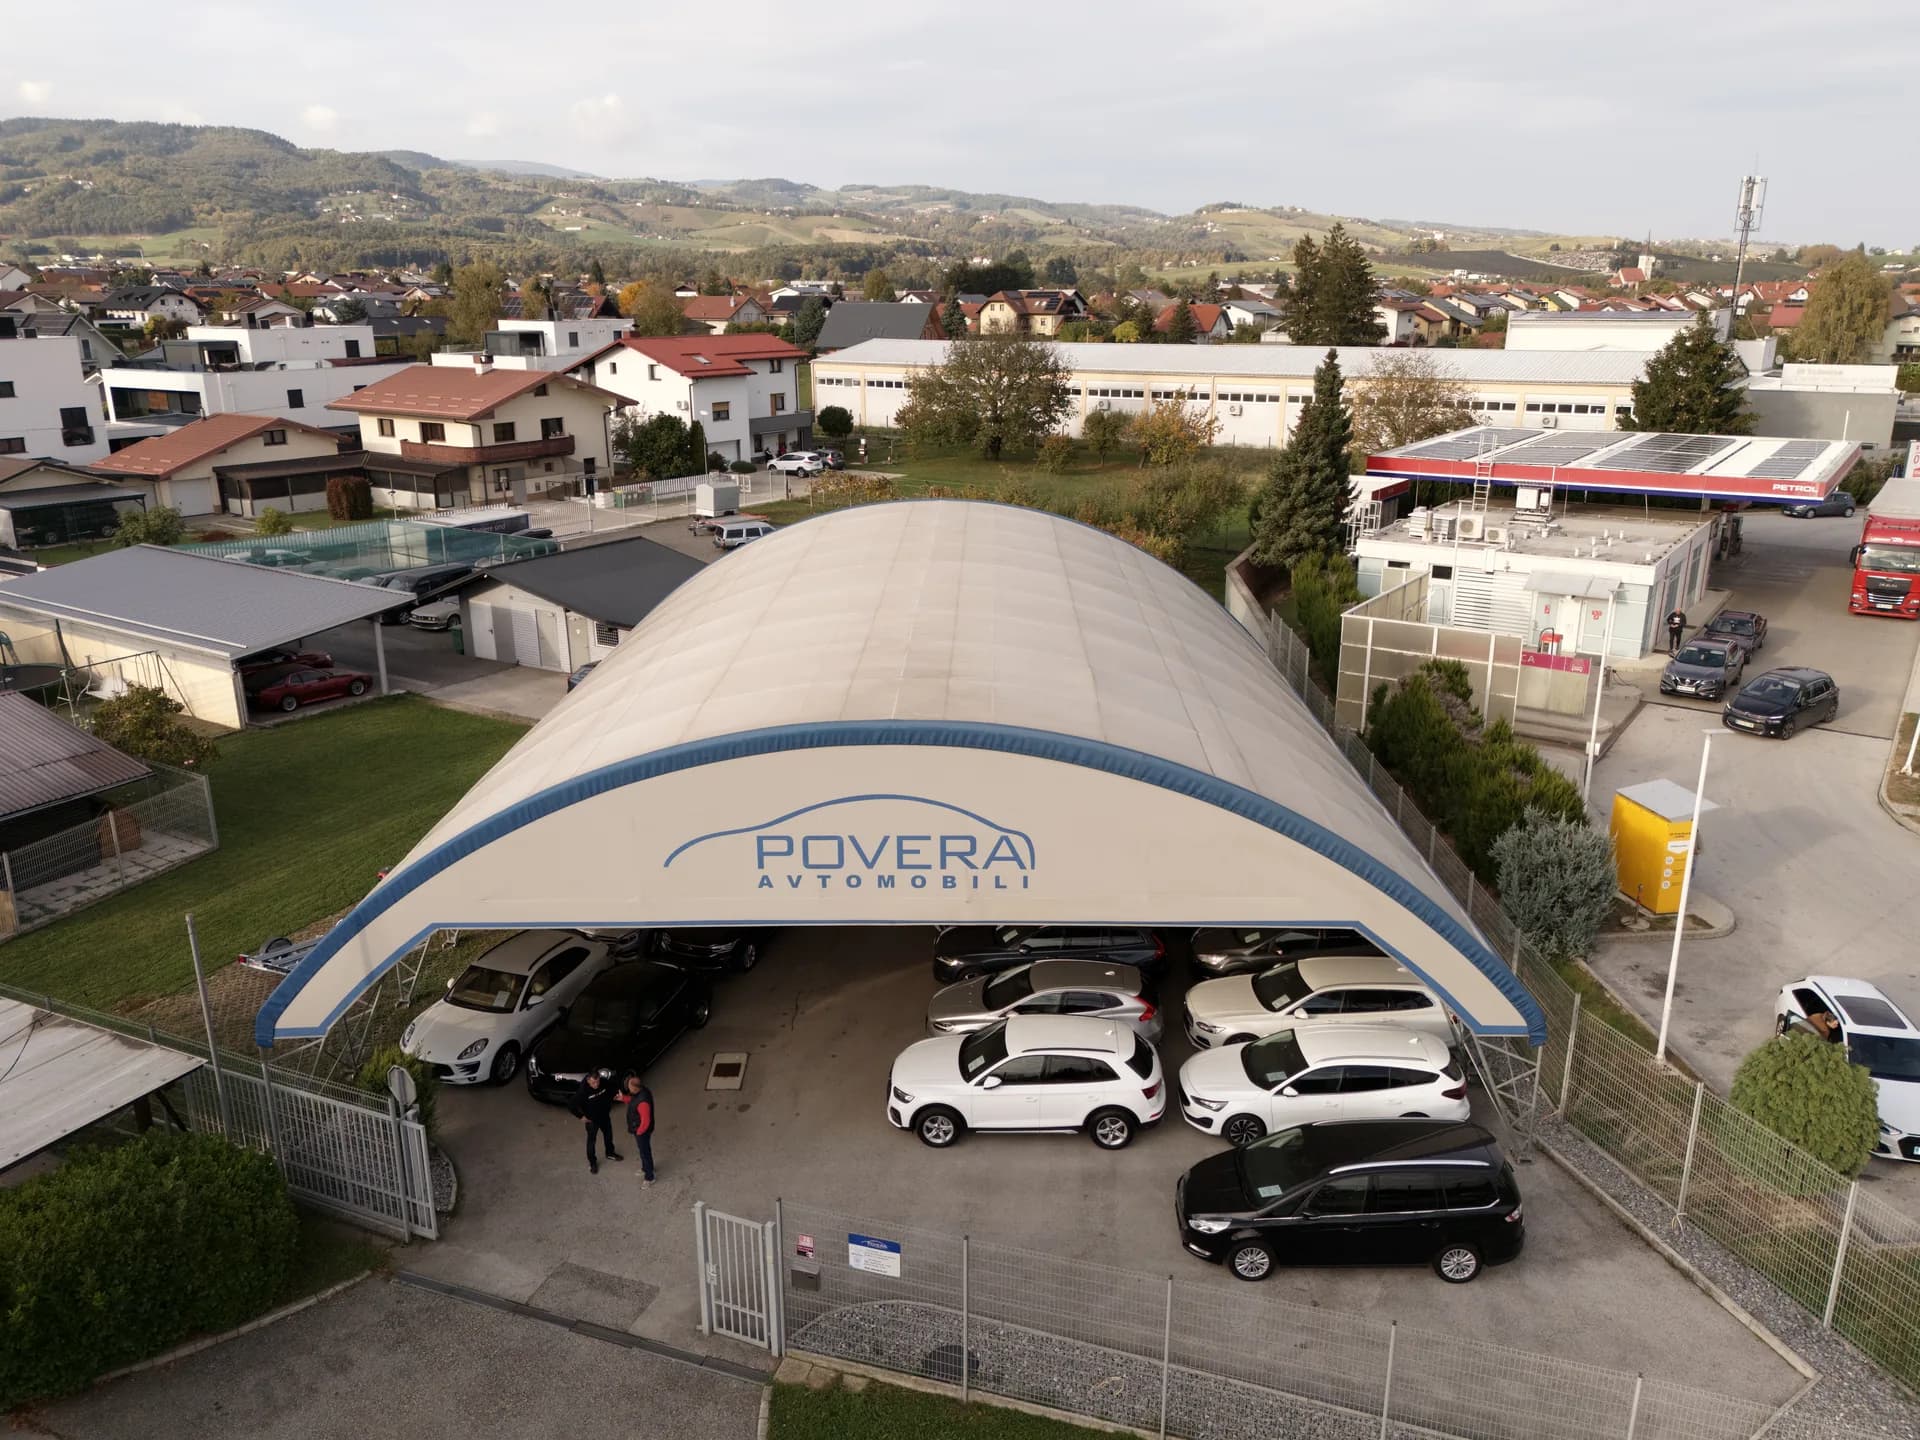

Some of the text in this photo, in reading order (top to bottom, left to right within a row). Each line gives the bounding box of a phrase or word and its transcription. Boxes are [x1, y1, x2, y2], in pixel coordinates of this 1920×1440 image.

[1772, 483, 1819, 494] PETROL
[756, 835, 1027, 870] POVERA
[757, 874, 1029, 889] AVTOMOBILI
